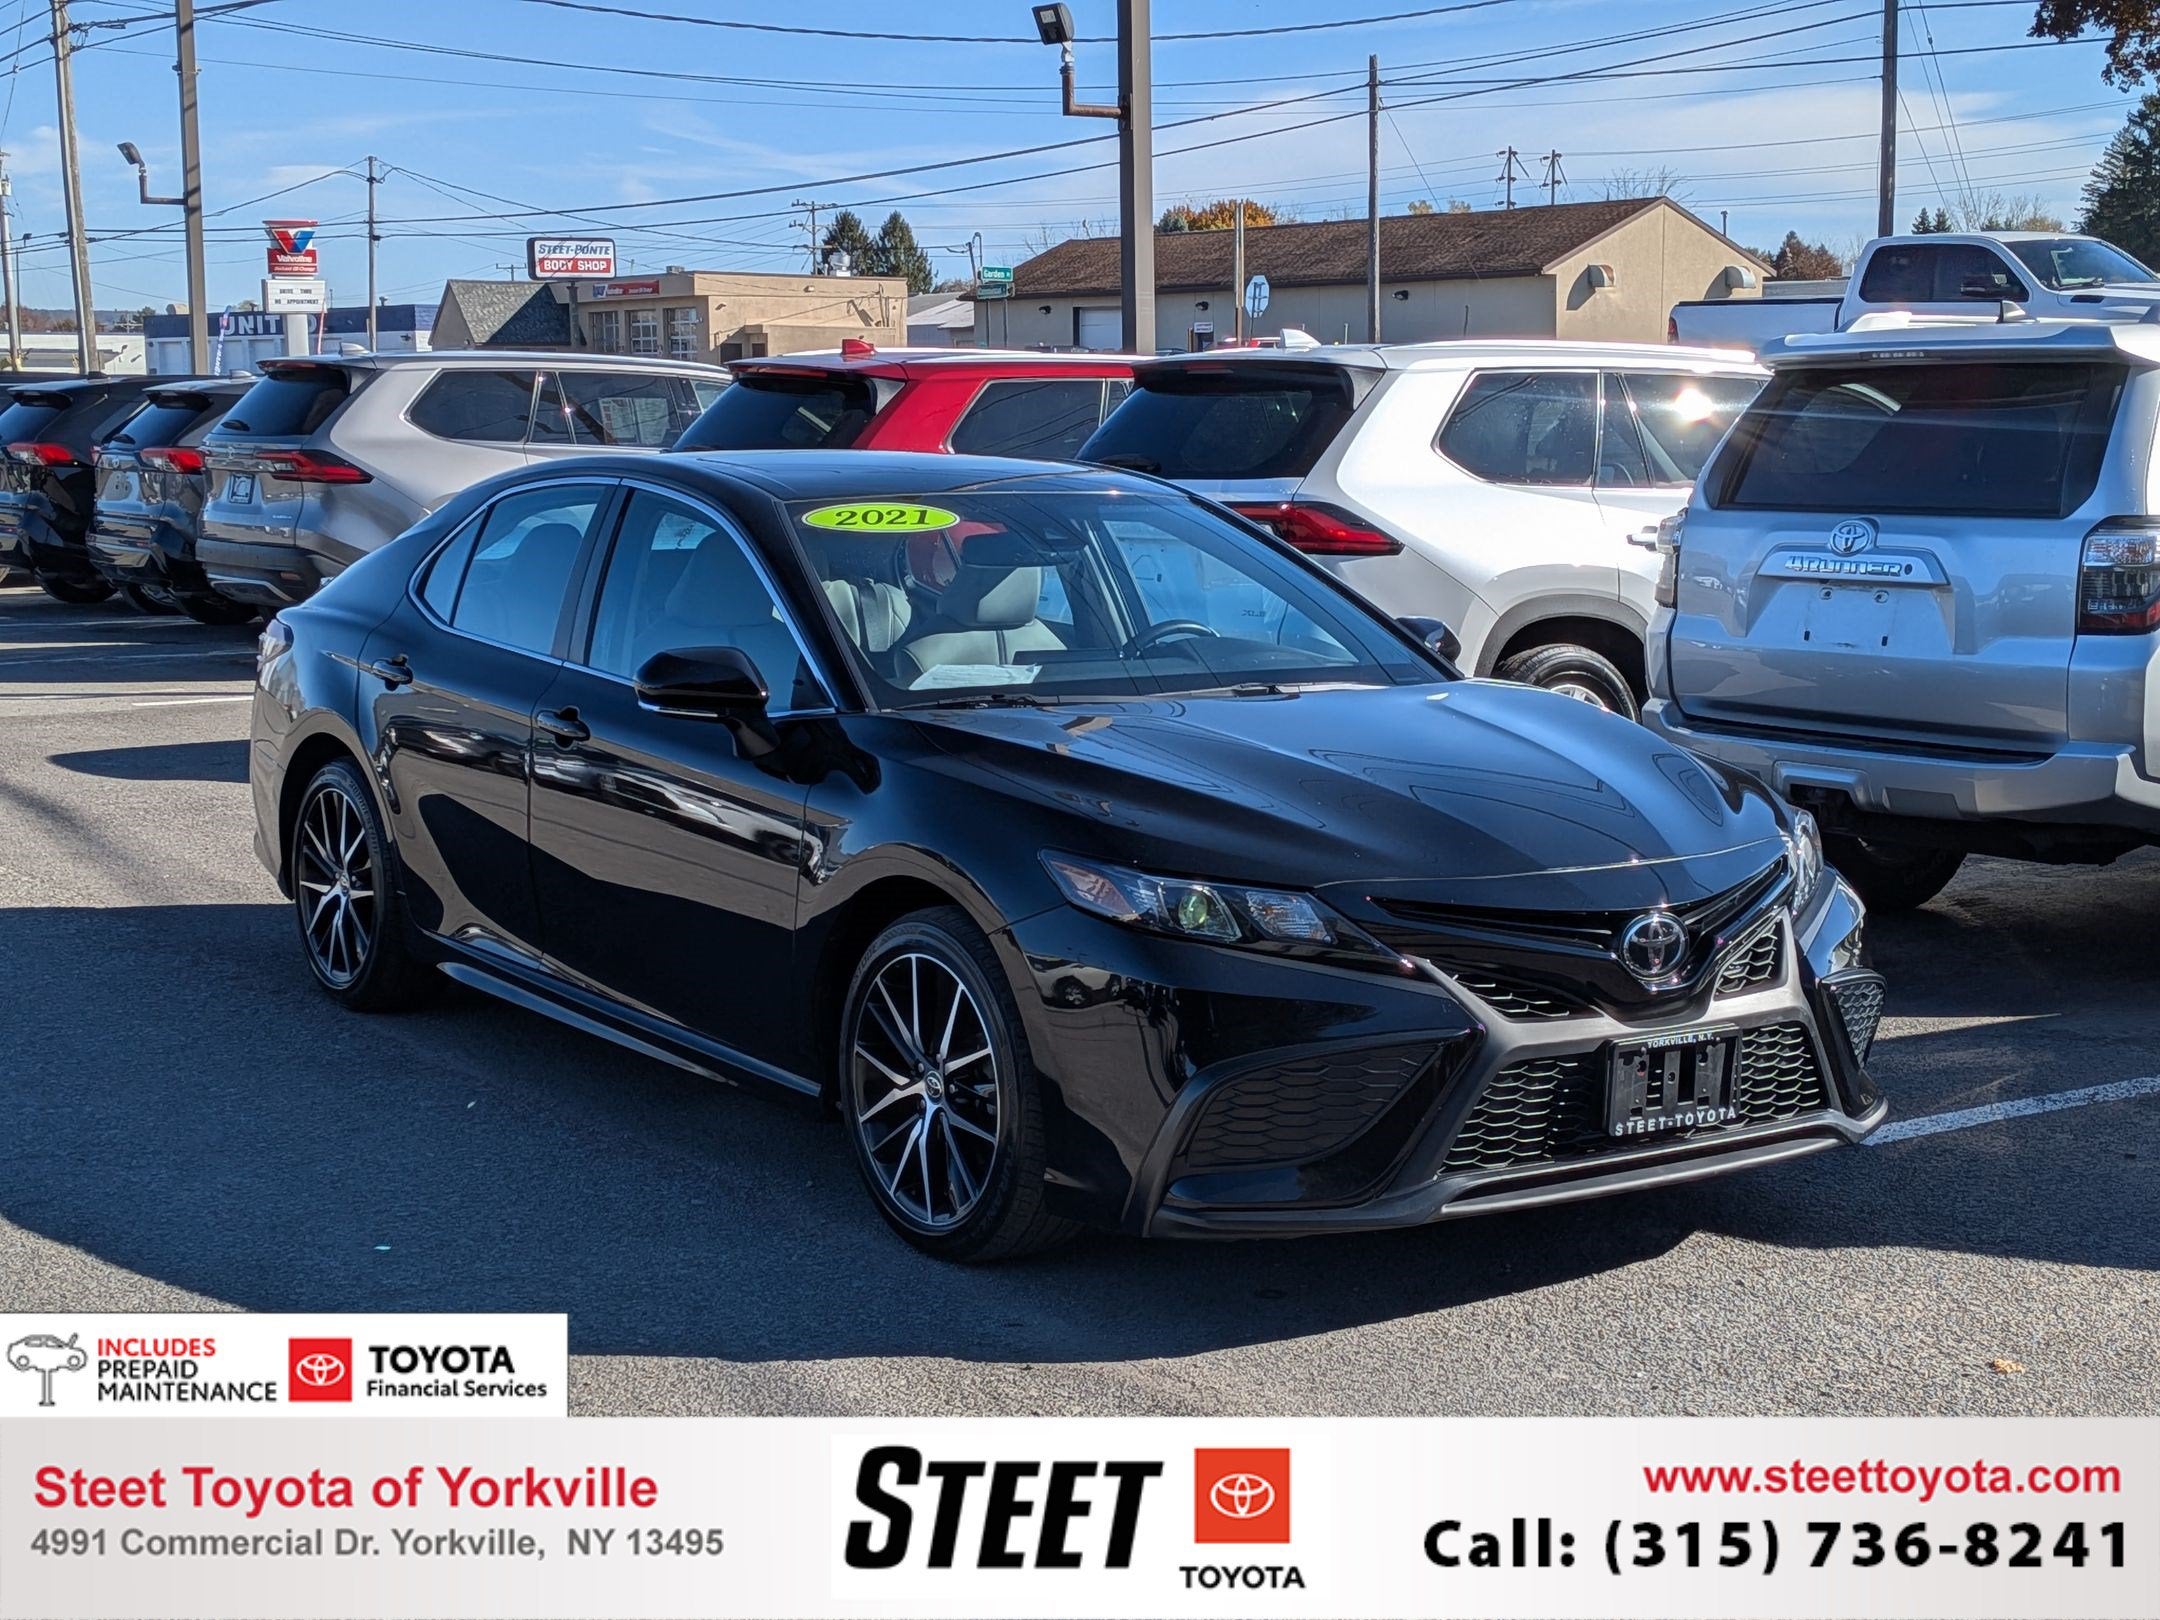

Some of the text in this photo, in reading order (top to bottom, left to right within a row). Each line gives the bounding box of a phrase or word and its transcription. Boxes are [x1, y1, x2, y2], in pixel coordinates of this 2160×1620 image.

[538, 244, 611, 255] STEET-PONTE
[276, 254, 313, 263] Valvoline
[544, 260, 607, 271] BODY SHOP
[983, 269, 1005, 278] Garden
[219, 314, 317, 335] UNITD
[835, 509, 930, 526] 2021
[1647, 1036, 1697, 1049] YORKVILLE,
